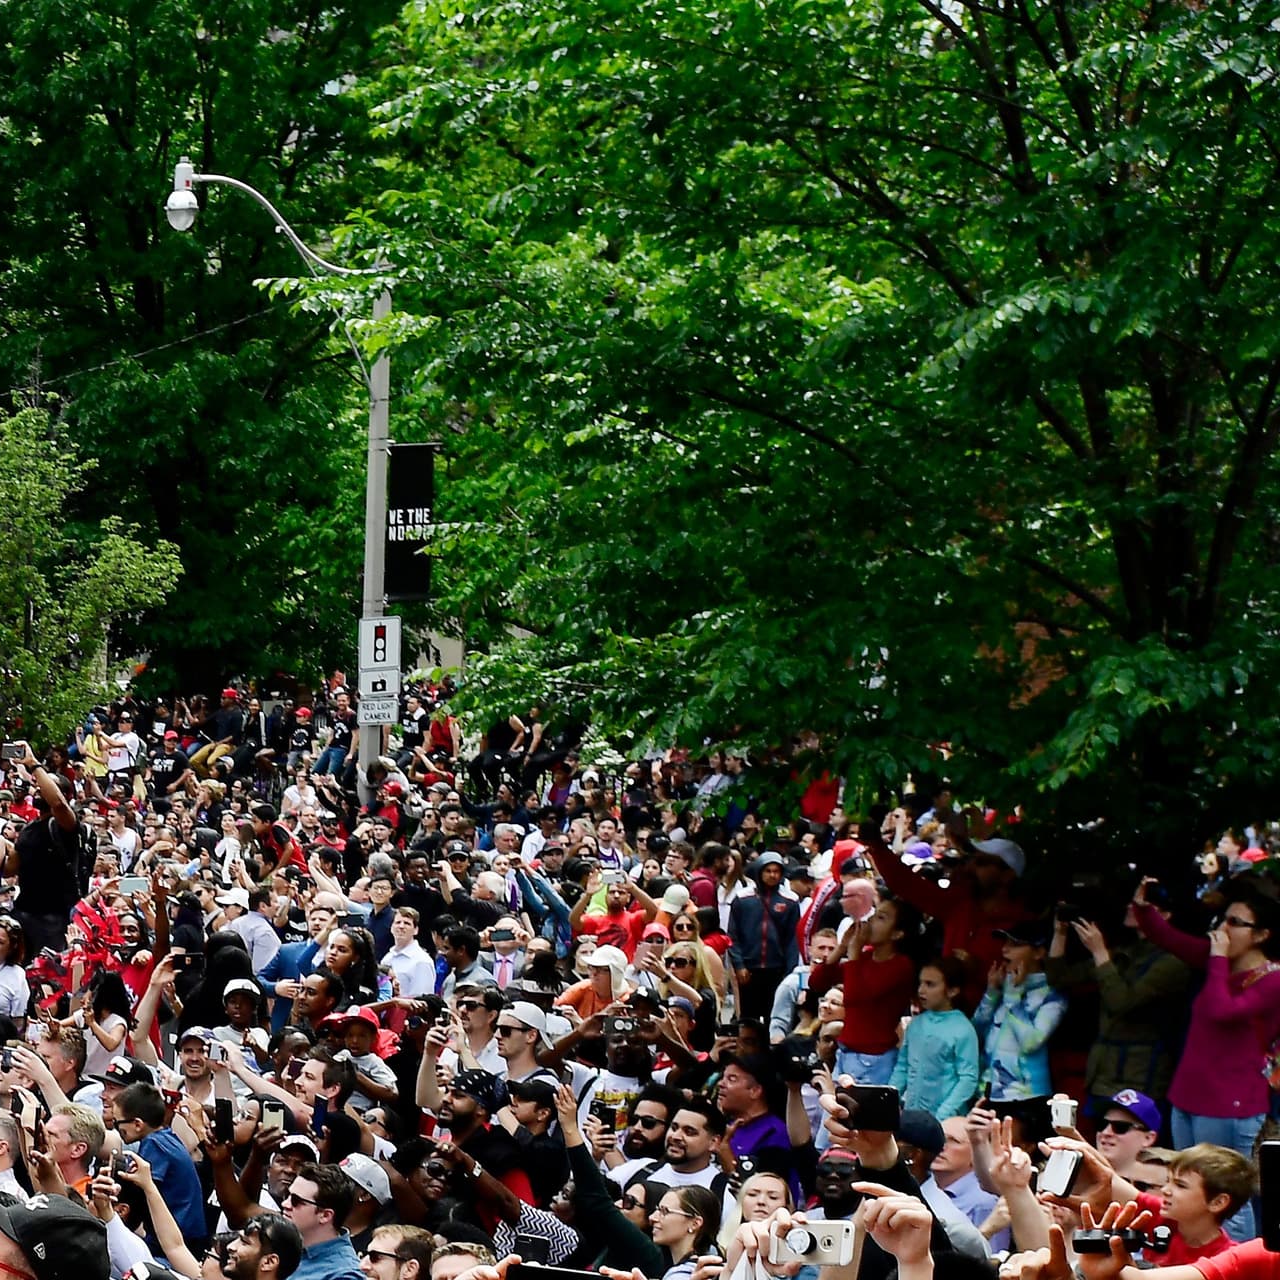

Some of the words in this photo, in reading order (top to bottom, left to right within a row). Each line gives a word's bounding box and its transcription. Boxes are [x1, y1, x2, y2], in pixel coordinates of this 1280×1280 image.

[406, 508, 431, 525] THE
[361, 703, 375, 711] RED
[364, 712, 392, 721] CAMERA
